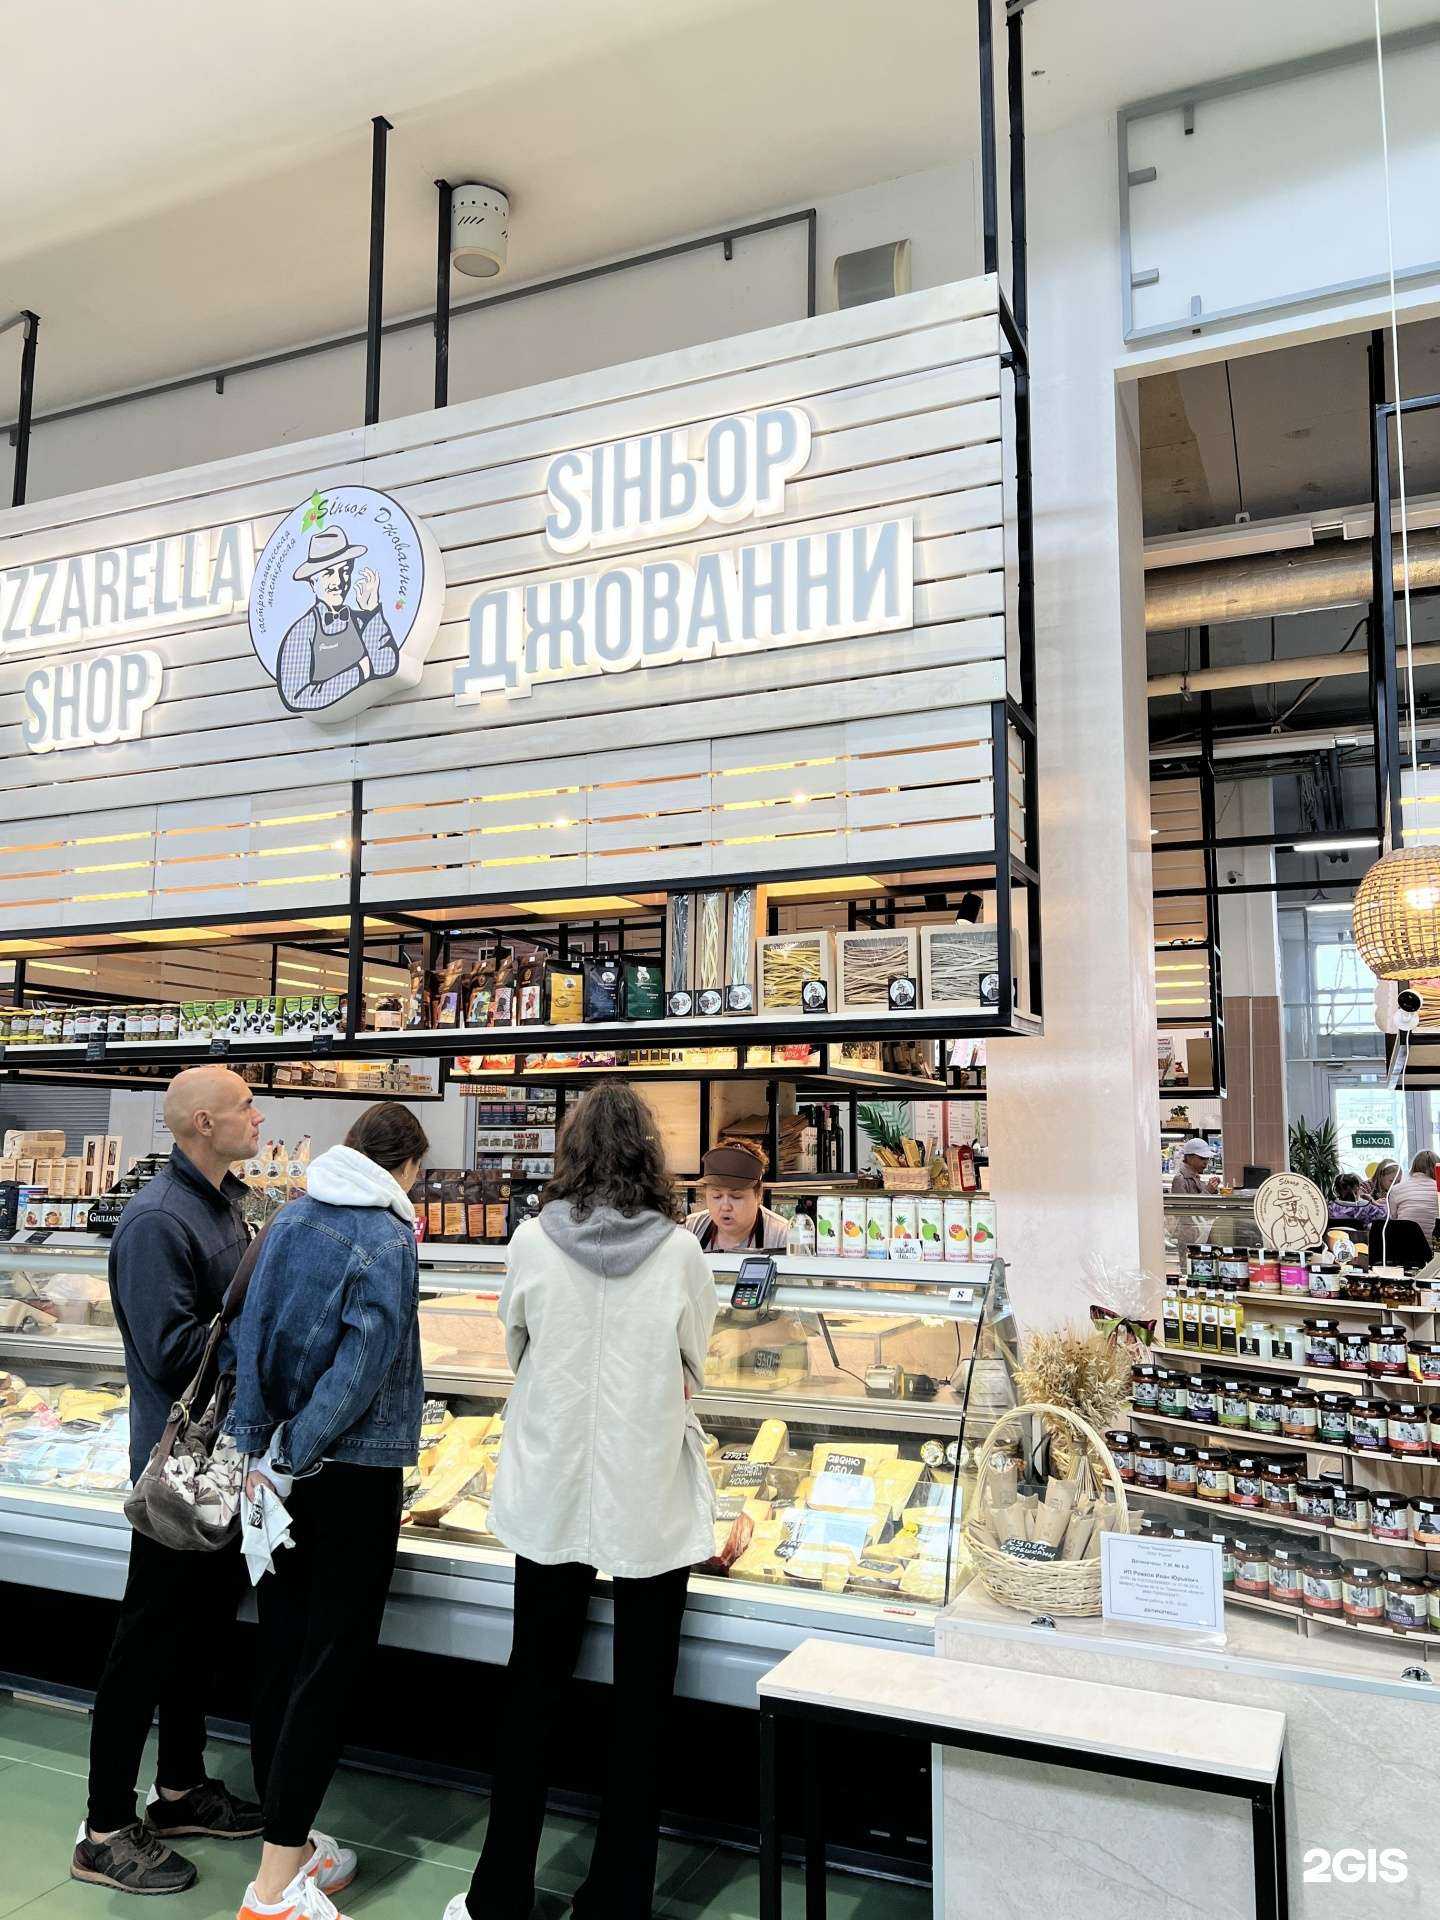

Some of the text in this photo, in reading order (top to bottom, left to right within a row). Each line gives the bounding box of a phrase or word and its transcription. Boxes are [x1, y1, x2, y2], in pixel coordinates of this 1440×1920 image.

[0, 523, 245, 642] ZZARELLA
[453, 521, 900, 694] ДЖОВАННИ
[22, 653, 149, 746] SHOP
[1355, 1137, 1391, 1146] ВЫХОД
